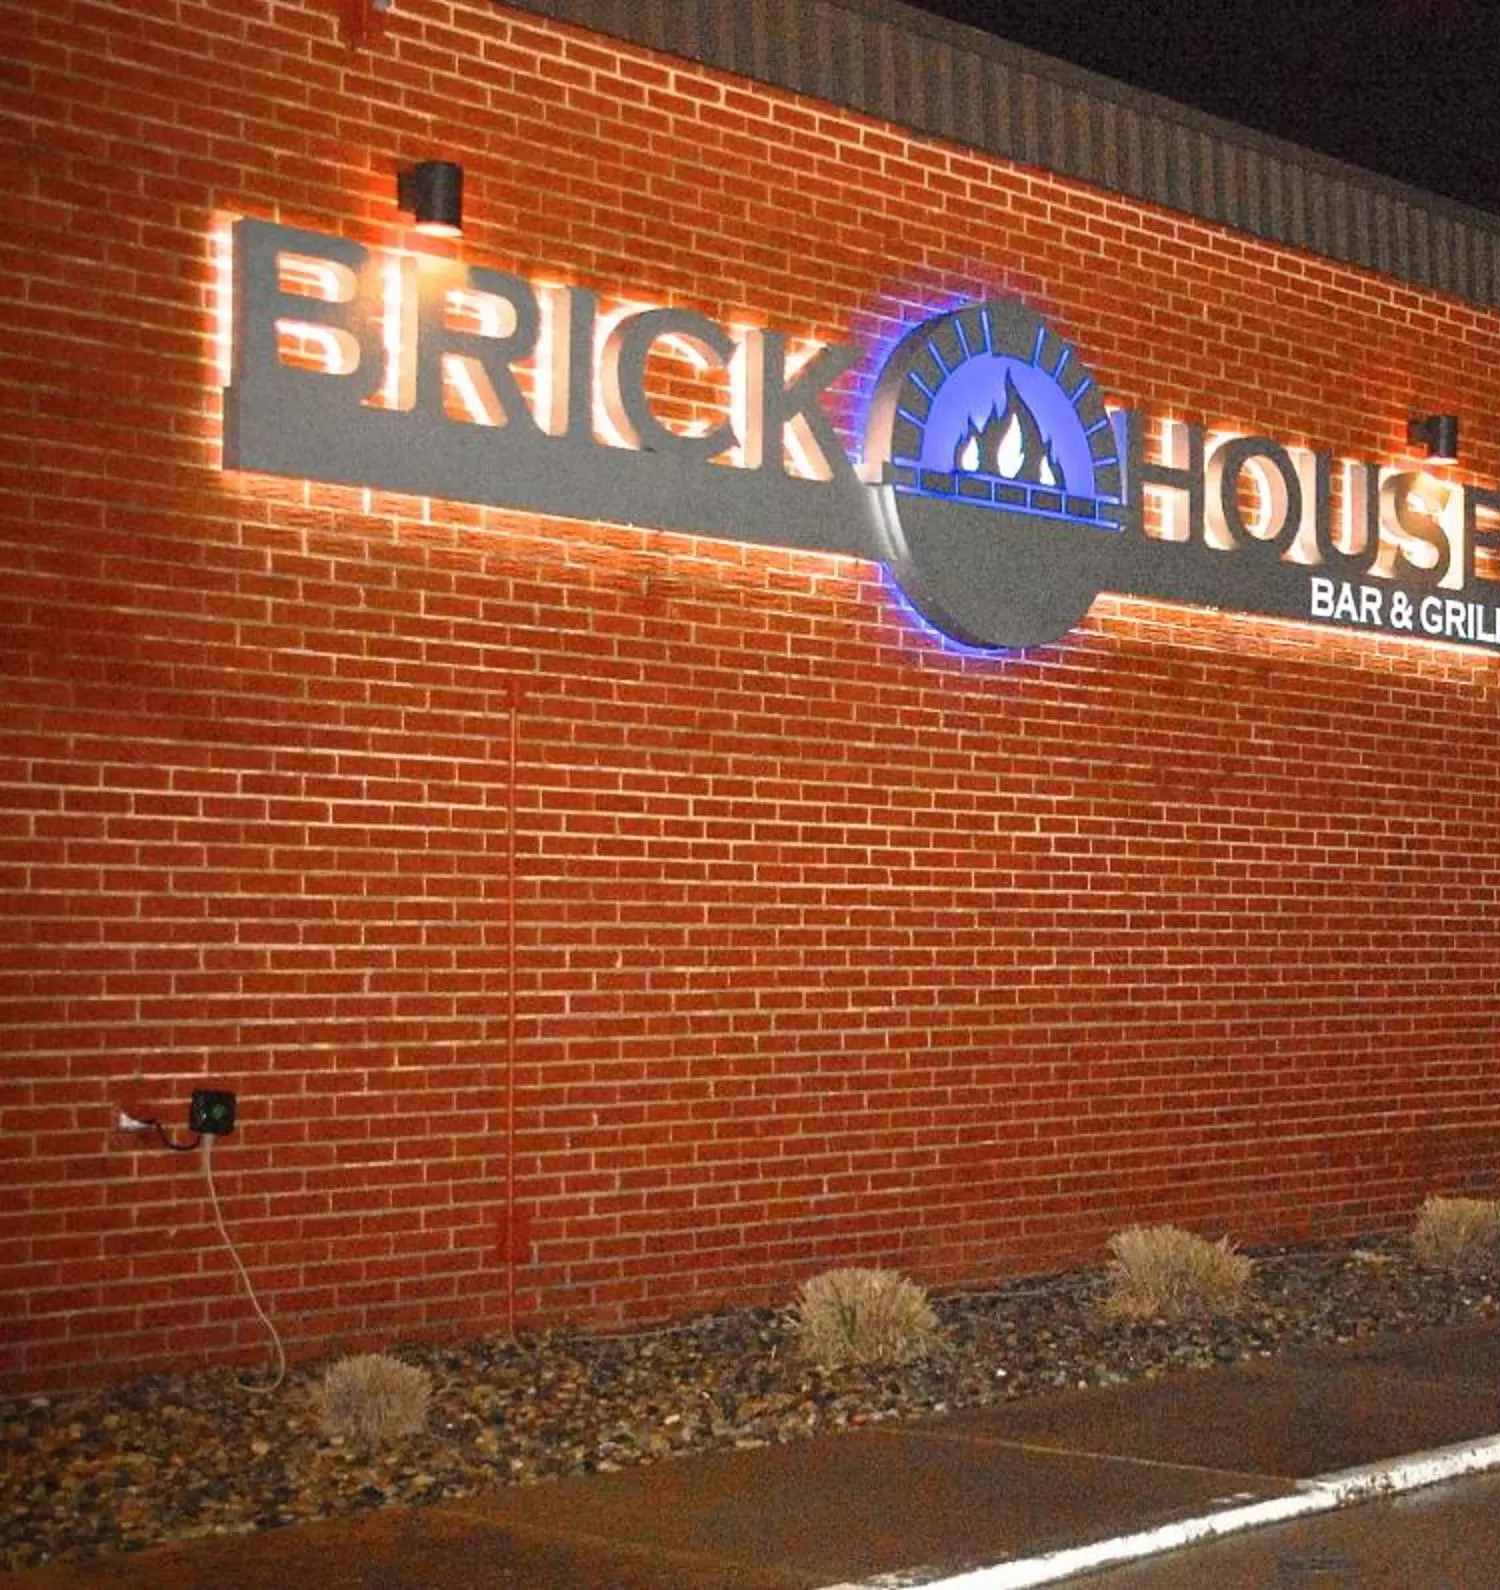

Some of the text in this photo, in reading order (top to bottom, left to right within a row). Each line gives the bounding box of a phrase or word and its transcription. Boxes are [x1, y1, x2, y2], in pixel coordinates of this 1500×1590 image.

[231, 216, 864, 484] BRICK
[1310, 577, 1382, 626] BAR
[1389, 591, 1413, 631] &
